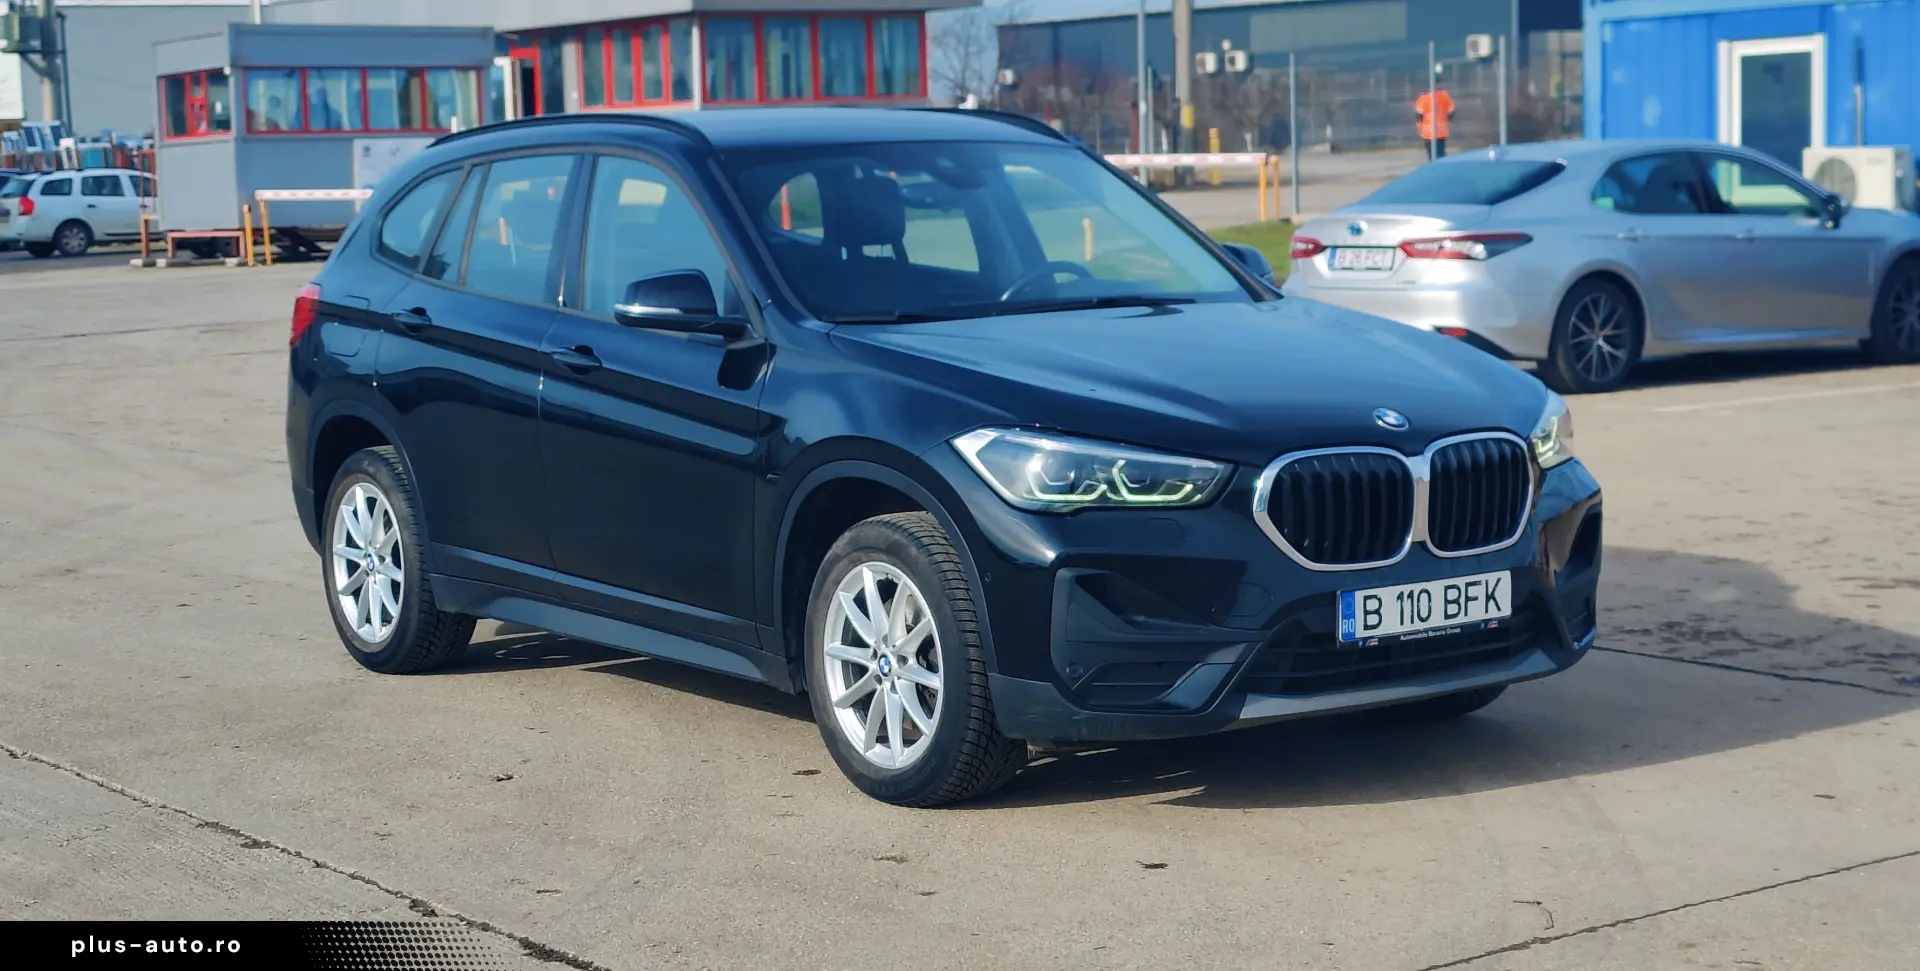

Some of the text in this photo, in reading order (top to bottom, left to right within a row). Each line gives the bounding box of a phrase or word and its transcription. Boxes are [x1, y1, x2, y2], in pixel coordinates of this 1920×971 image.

[1338, 249, 1346, 265] B
[1363, 577, 1502, 631] B 110 BFK
[1342, 618, 1355, 634] RO
[1399, 631, 1428, 641] Automobile
